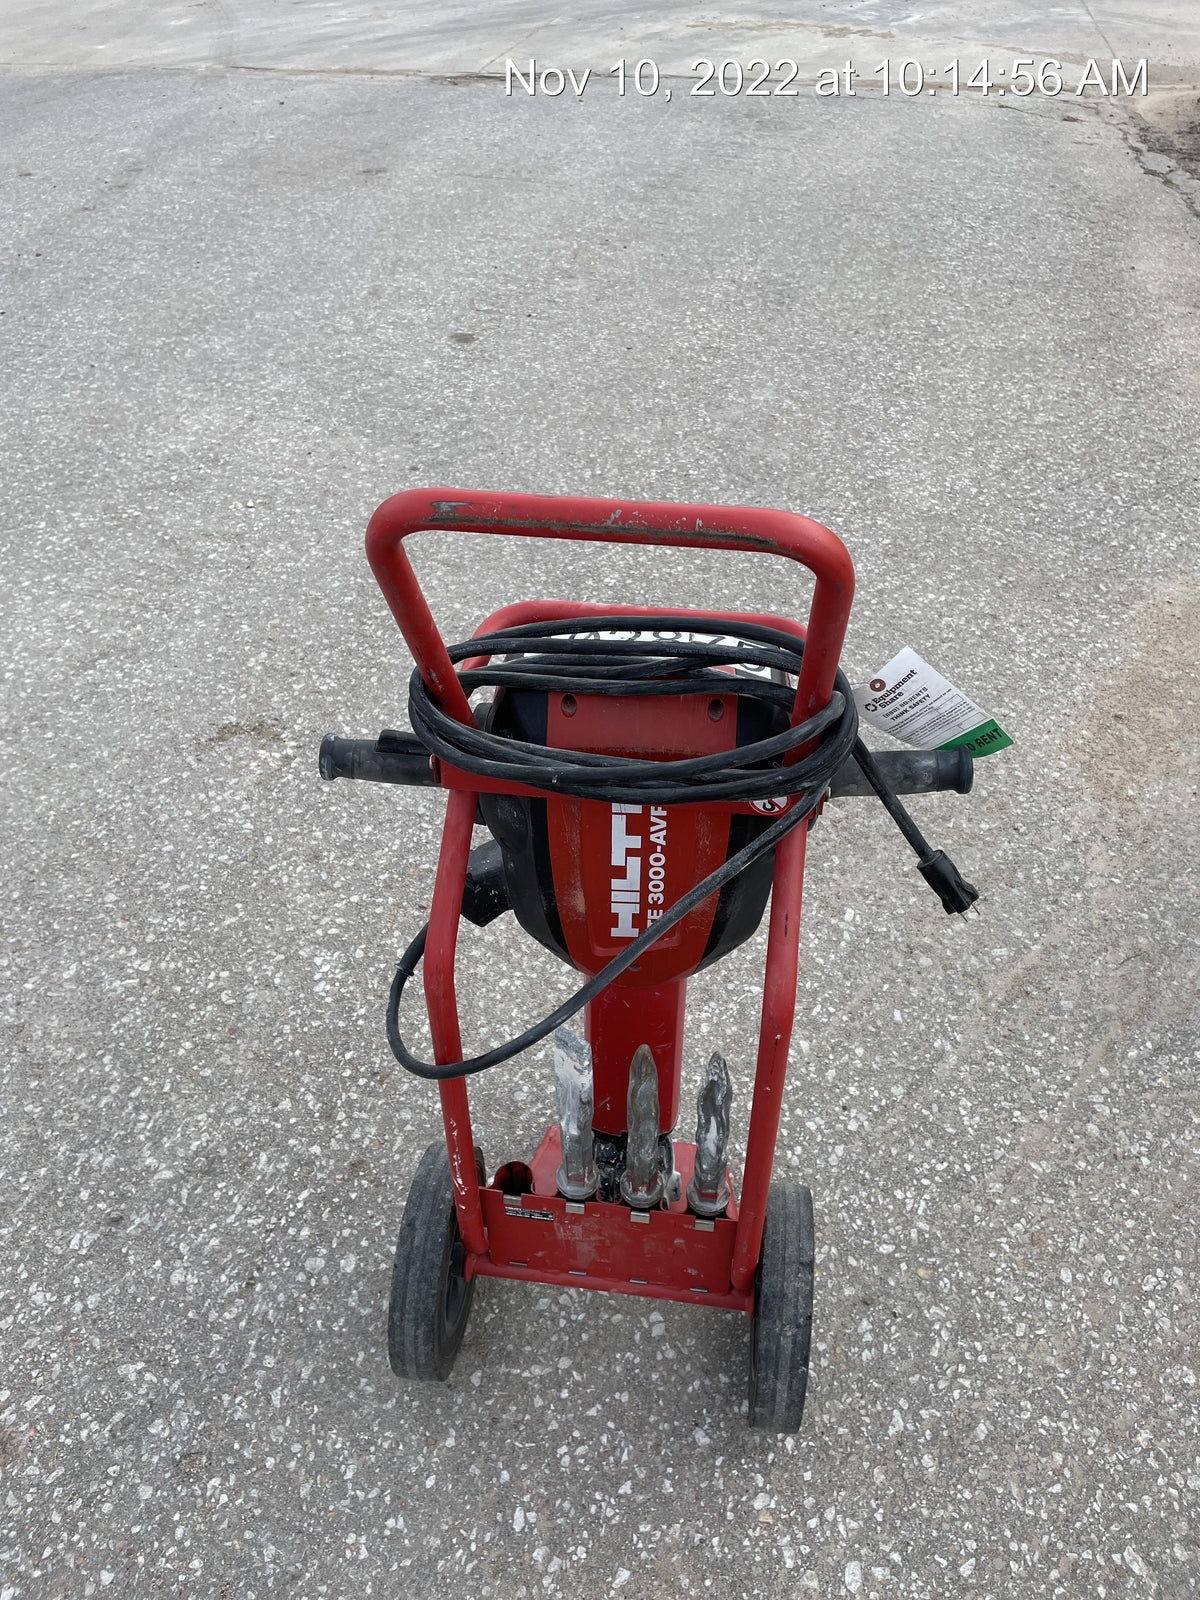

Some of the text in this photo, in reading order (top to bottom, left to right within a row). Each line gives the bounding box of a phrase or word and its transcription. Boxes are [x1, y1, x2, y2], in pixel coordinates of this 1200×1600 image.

[872, 669, 917, 704] Equipment
[878, 691, 904, 709] Share
[890, 693, 931, 721] THINK SAFETY
[974, 727, 1003, 748] RENT
[610, 802, 643, 937] HILTI
